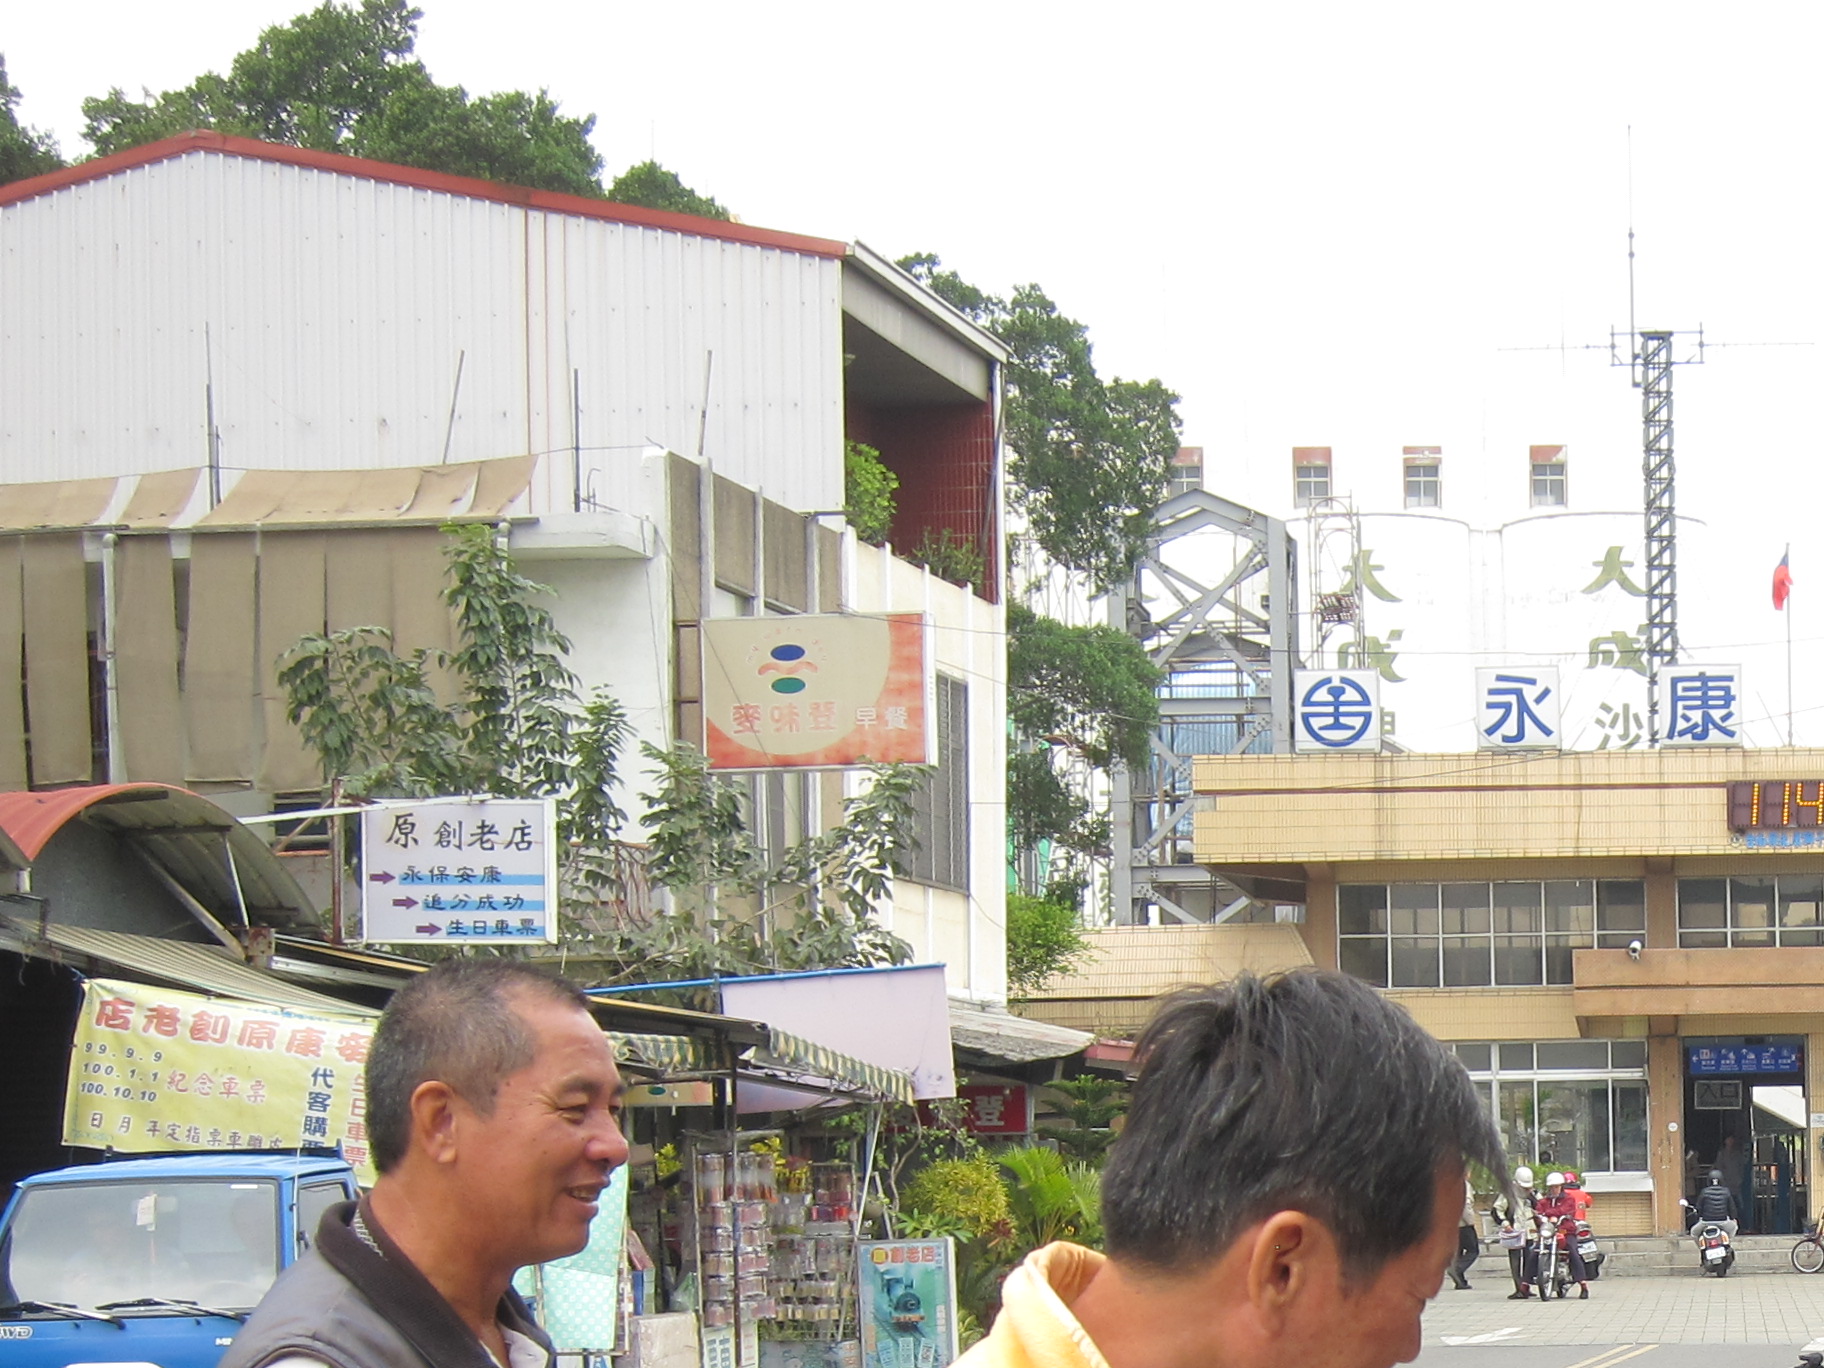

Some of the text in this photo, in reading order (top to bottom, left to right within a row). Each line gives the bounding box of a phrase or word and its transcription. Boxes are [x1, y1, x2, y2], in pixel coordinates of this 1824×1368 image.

[856, 705, 908, 730] 早餐
[385, 812, 534, 852] 原創老店
[401, 865, 503, 884] 永保安康
[424, 893, 526, 911] 追分成功
[446, 918, 539, 936] 生日車票
[80, 1082, 157, 1103] 100.10.10
[166, 1069, 267, 1104] 紀念車票
